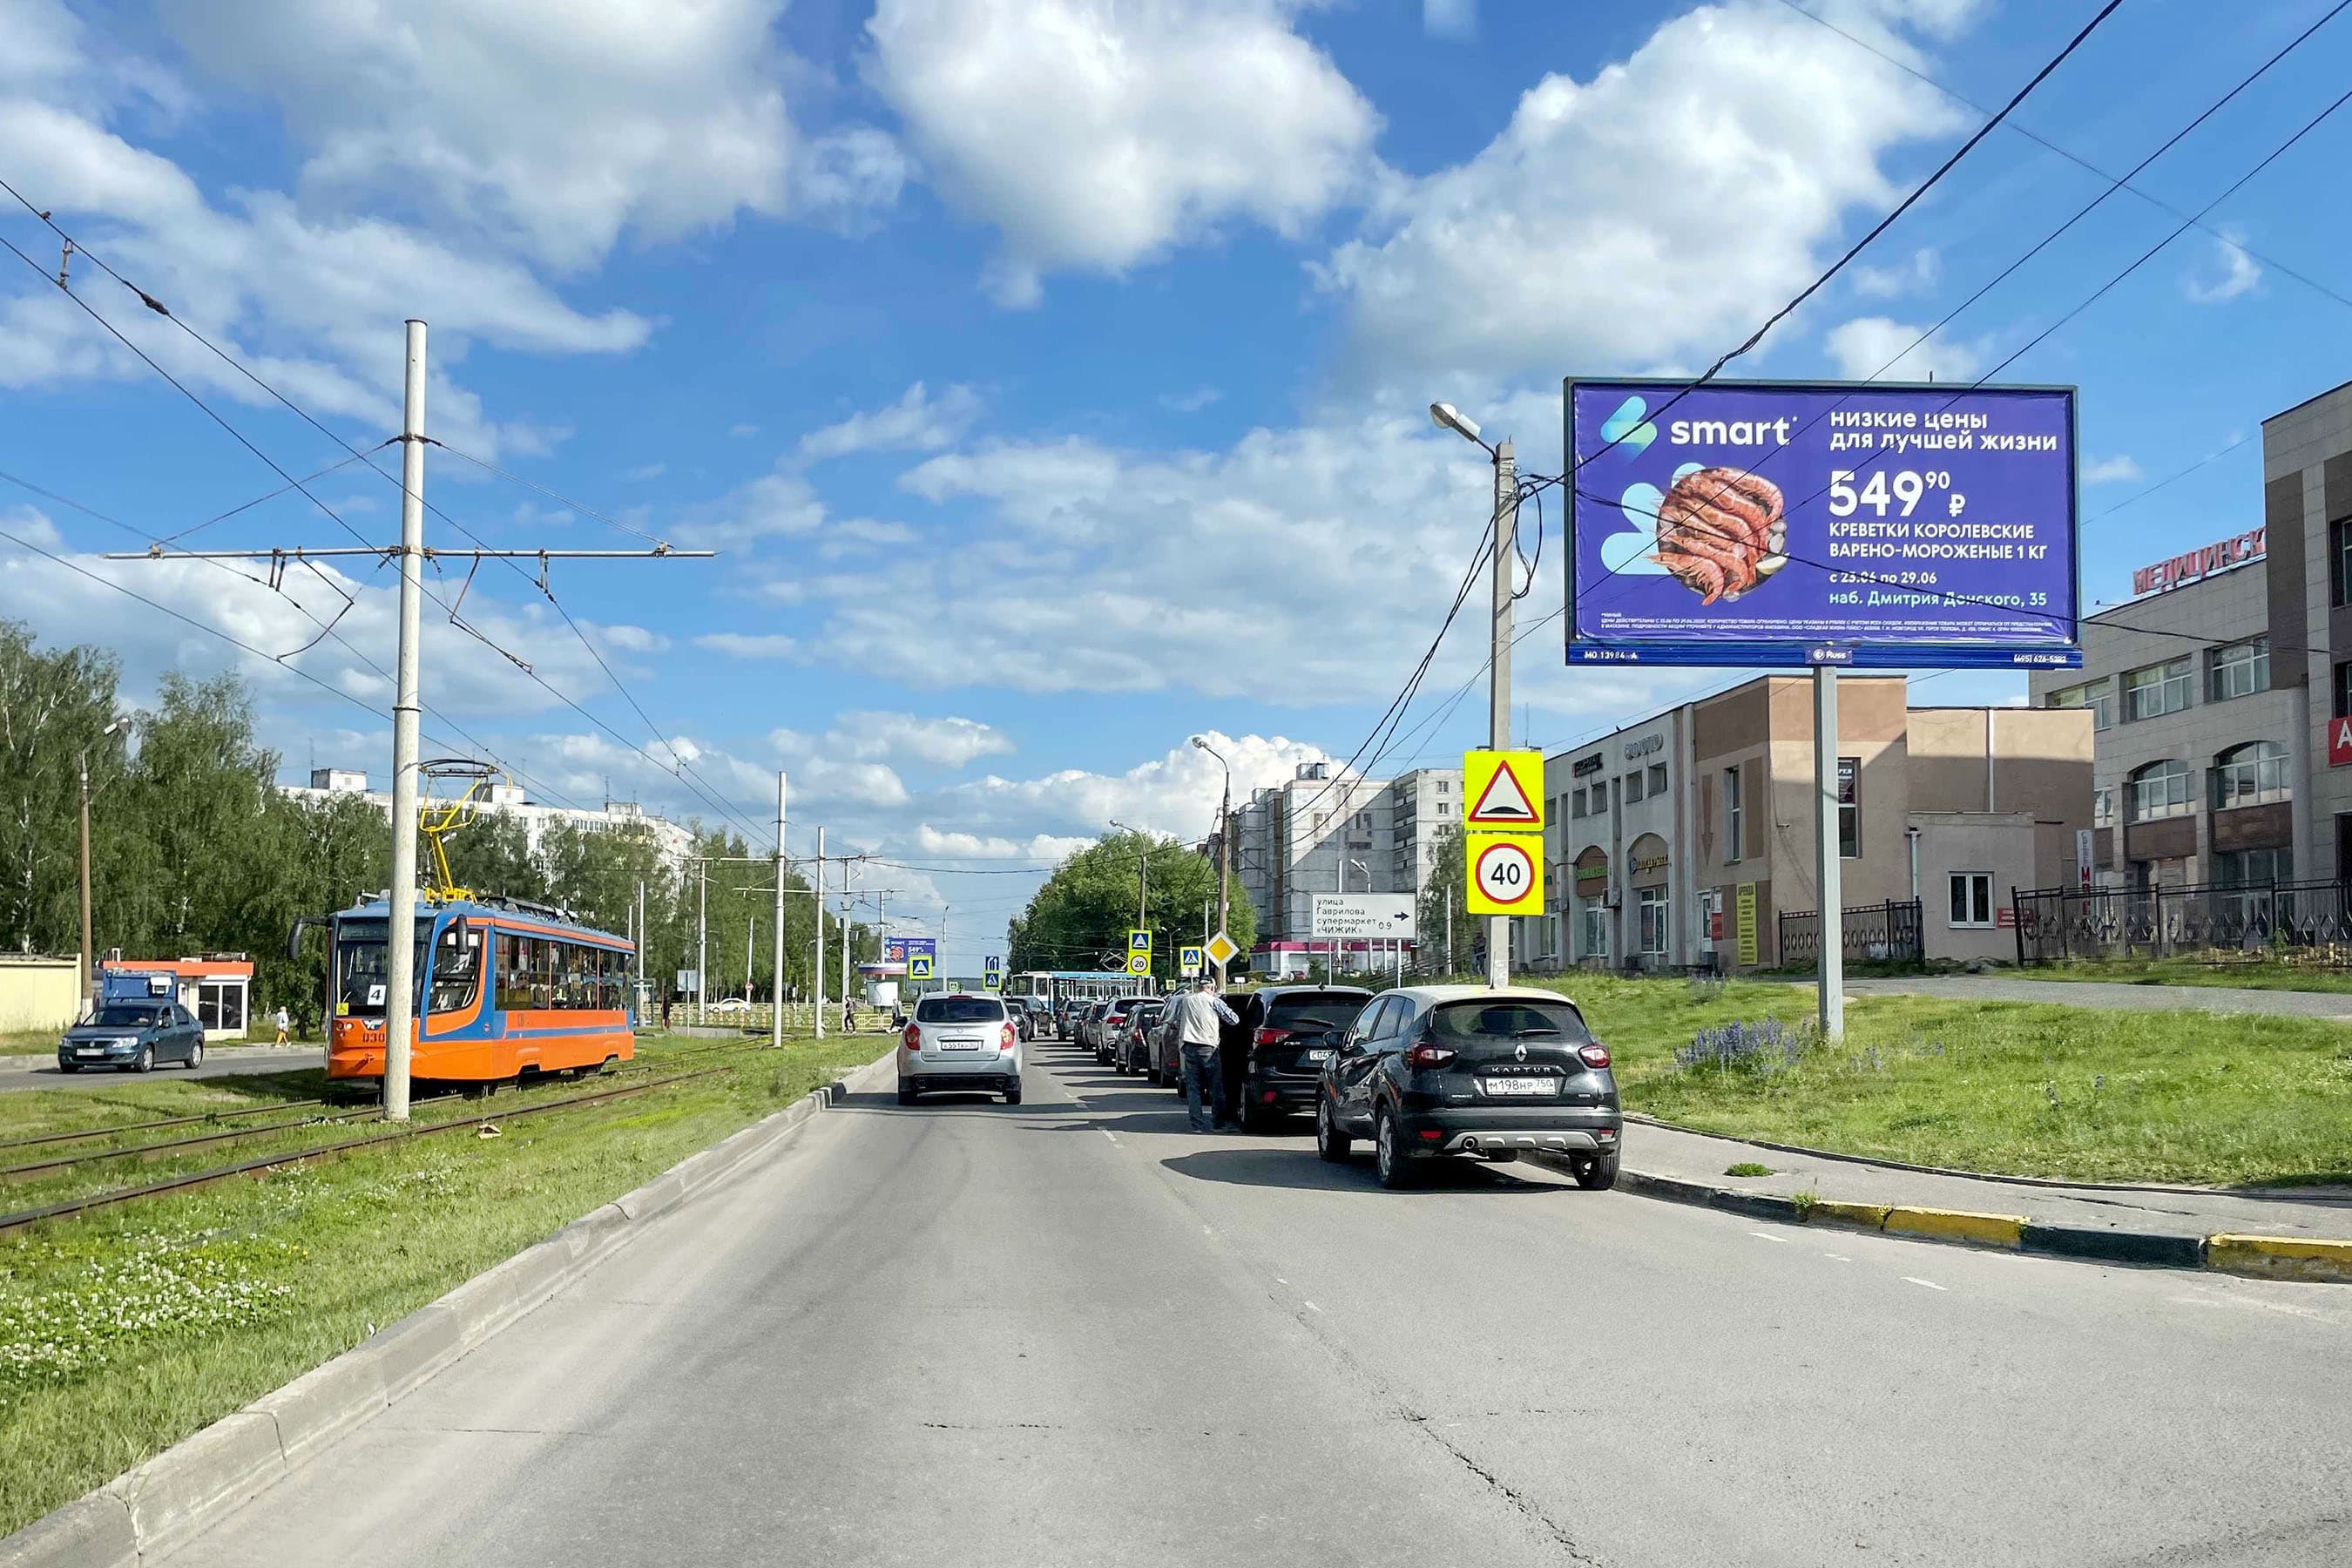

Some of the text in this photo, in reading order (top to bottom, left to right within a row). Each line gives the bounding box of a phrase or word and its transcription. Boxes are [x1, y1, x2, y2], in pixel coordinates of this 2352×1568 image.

[1830, 411, 1988, 431] низкие цены
[1671, 416, 1791, 446] smart
[1830, 429, 2058, 454] для лучшей жизни
[1828, 470, 1950, 517] 549 90
[1829, 523, 2035, 539] КРЕВЕТКИ КОРОЛЕВСКИЕ
[1829, 544, 2047, 560] ВАРЕНО-МОРОЖЕНЫЕ 1 КГ
[1829, 573, 1838, 584] с
[1880, 574, 1897, 584] по
[1901, 572, 1938, 585] 29.06
[1829, 591, 2047, 608] наб. Дмитрия Донского, 35
[1490, 862, 1521, 886] 40
[1316, 907, 1366, 916] Гаврилова
[1316, 917, 1377, 926] супермаркет
[370, 989, 382, 1001] 4
